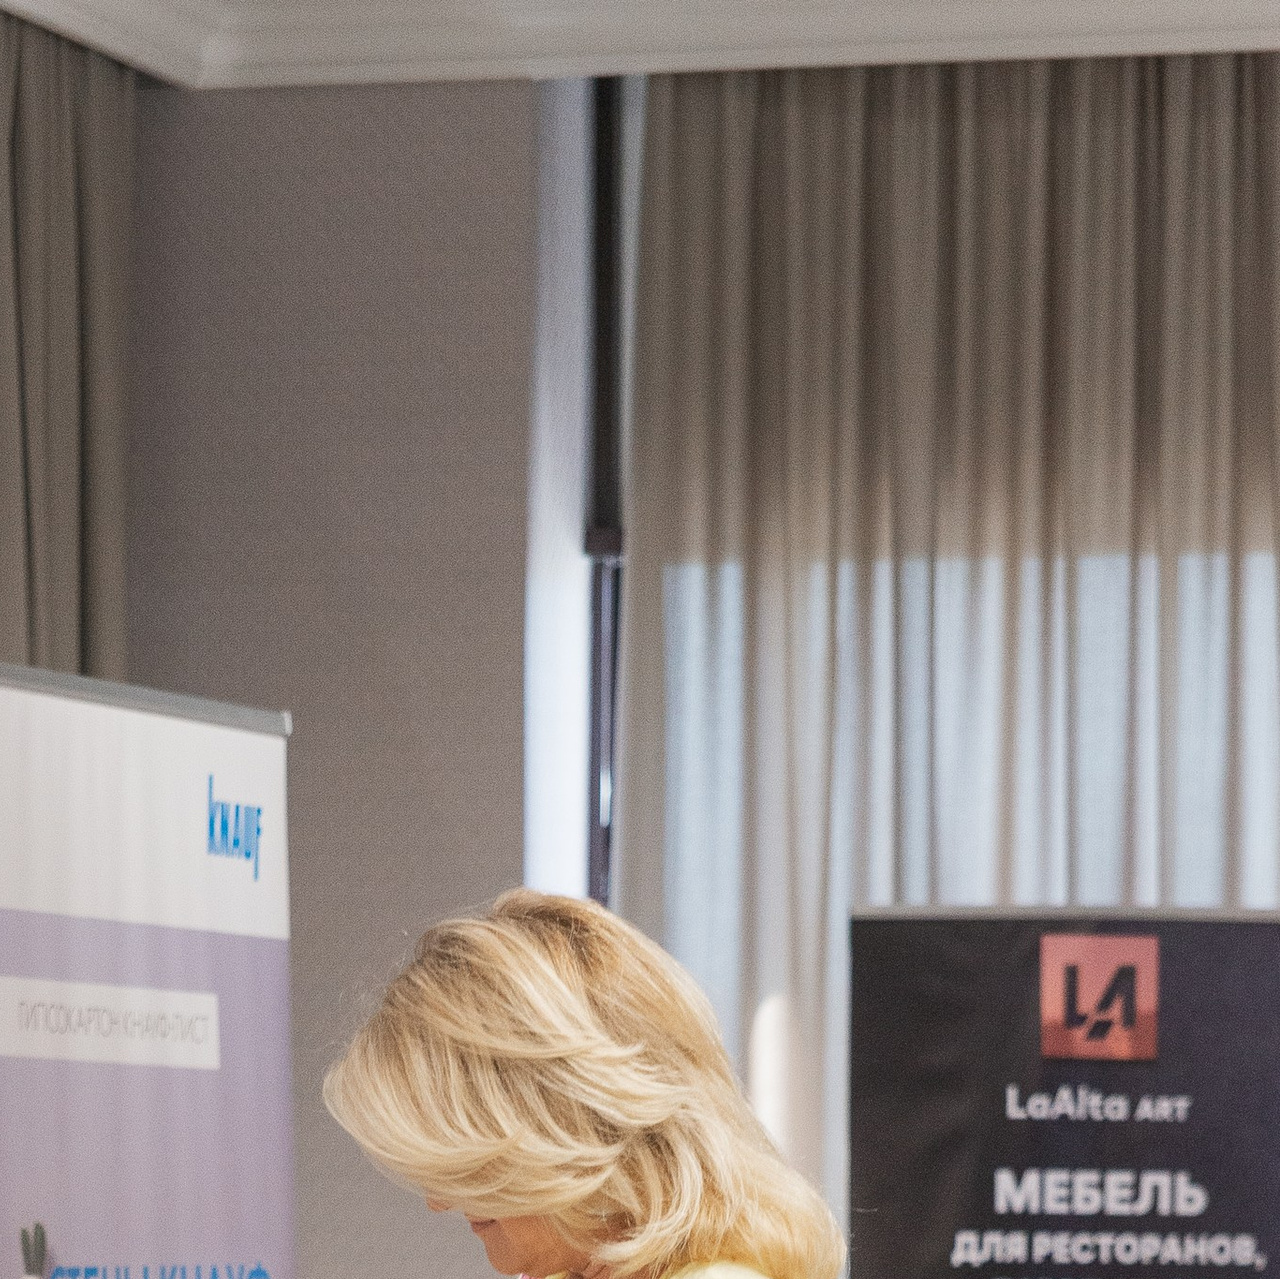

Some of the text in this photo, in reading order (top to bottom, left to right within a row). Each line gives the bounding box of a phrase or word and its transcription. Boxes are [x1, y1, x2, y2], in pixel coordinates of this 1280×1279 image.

[207, 773, 262, 882] KNAUF
[1005, 1084, 1192, 1123] LaAlta ART
[993, 1168, 1209, 1217] МЕБЕЛЬ
[951, 1229, 1269, 1271] ДЛЯ РЕСТОРАНОВ,
